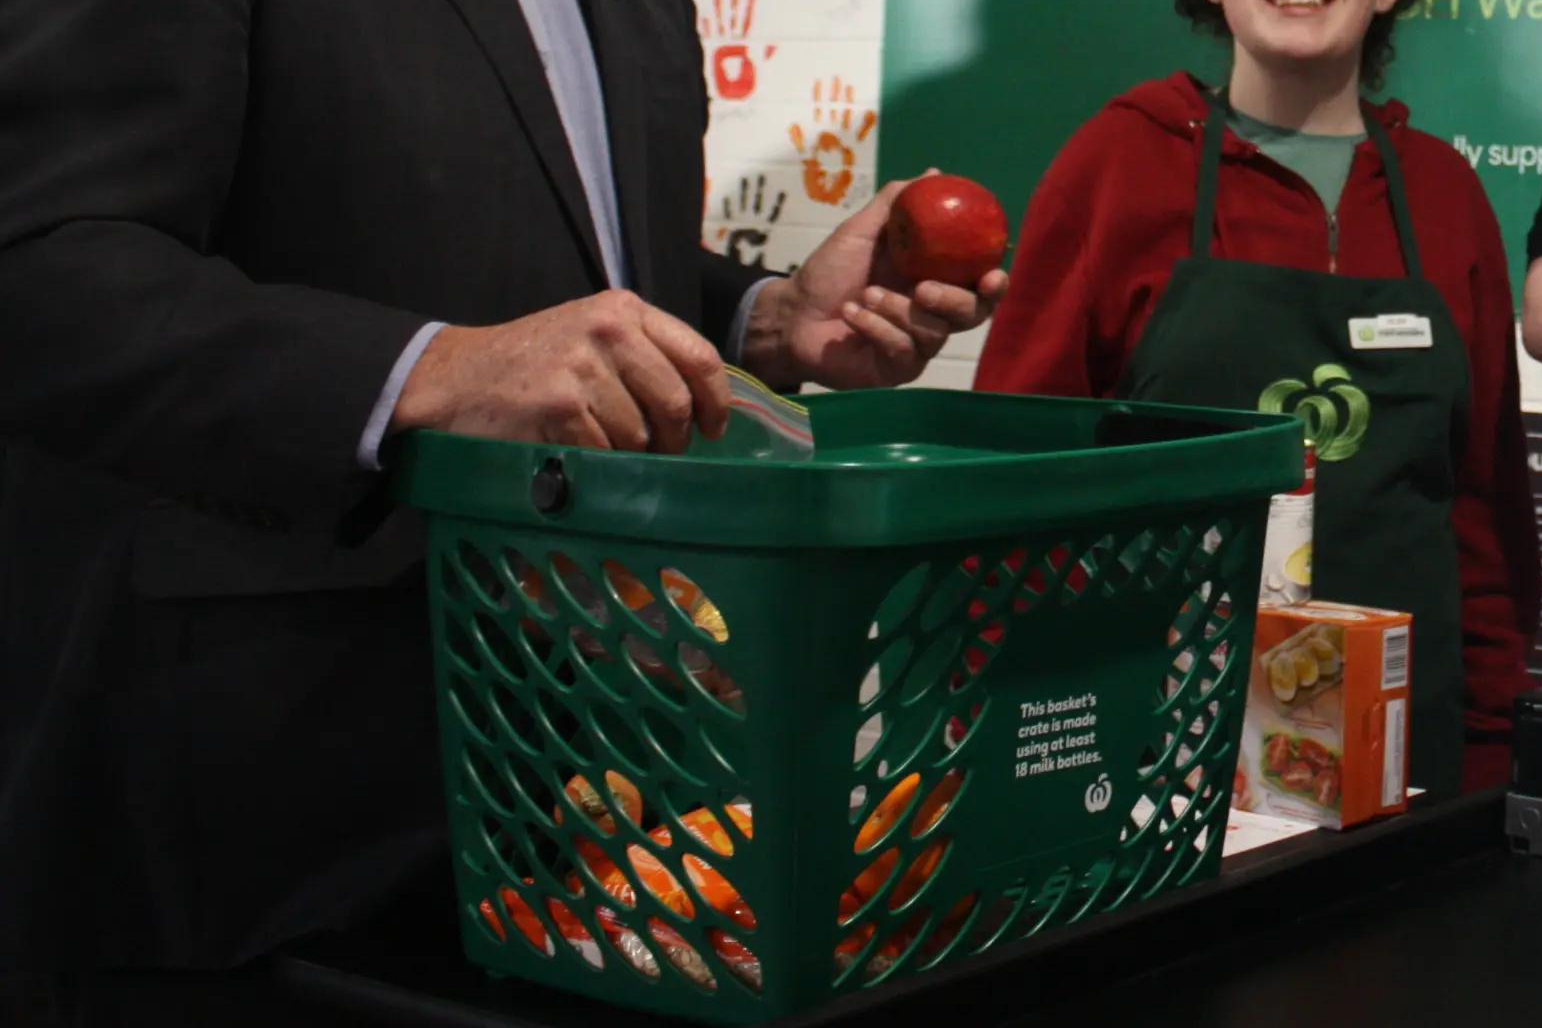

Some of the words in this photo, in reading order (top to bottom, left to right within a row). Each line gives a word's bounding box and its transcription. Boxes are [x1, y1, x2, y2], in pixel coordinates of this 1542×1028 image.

[1020, 700, 1045, 719] This
[1047, 692, 1097, 714] basket's
[1018, 720, 1049, 738] crate
[1051, 718, 1062, 733] is
[1063, 712, 1097, 729] made
[1016, 740, 1049, 758] using
[1051, 737, 1064, 752] at
[1065, 731, 1096, 748] least
[1015, 761, 1028, 778] 18
[1029, 758, 1055, 775] milk
[1057, 750, 1102, 769] bottles.
